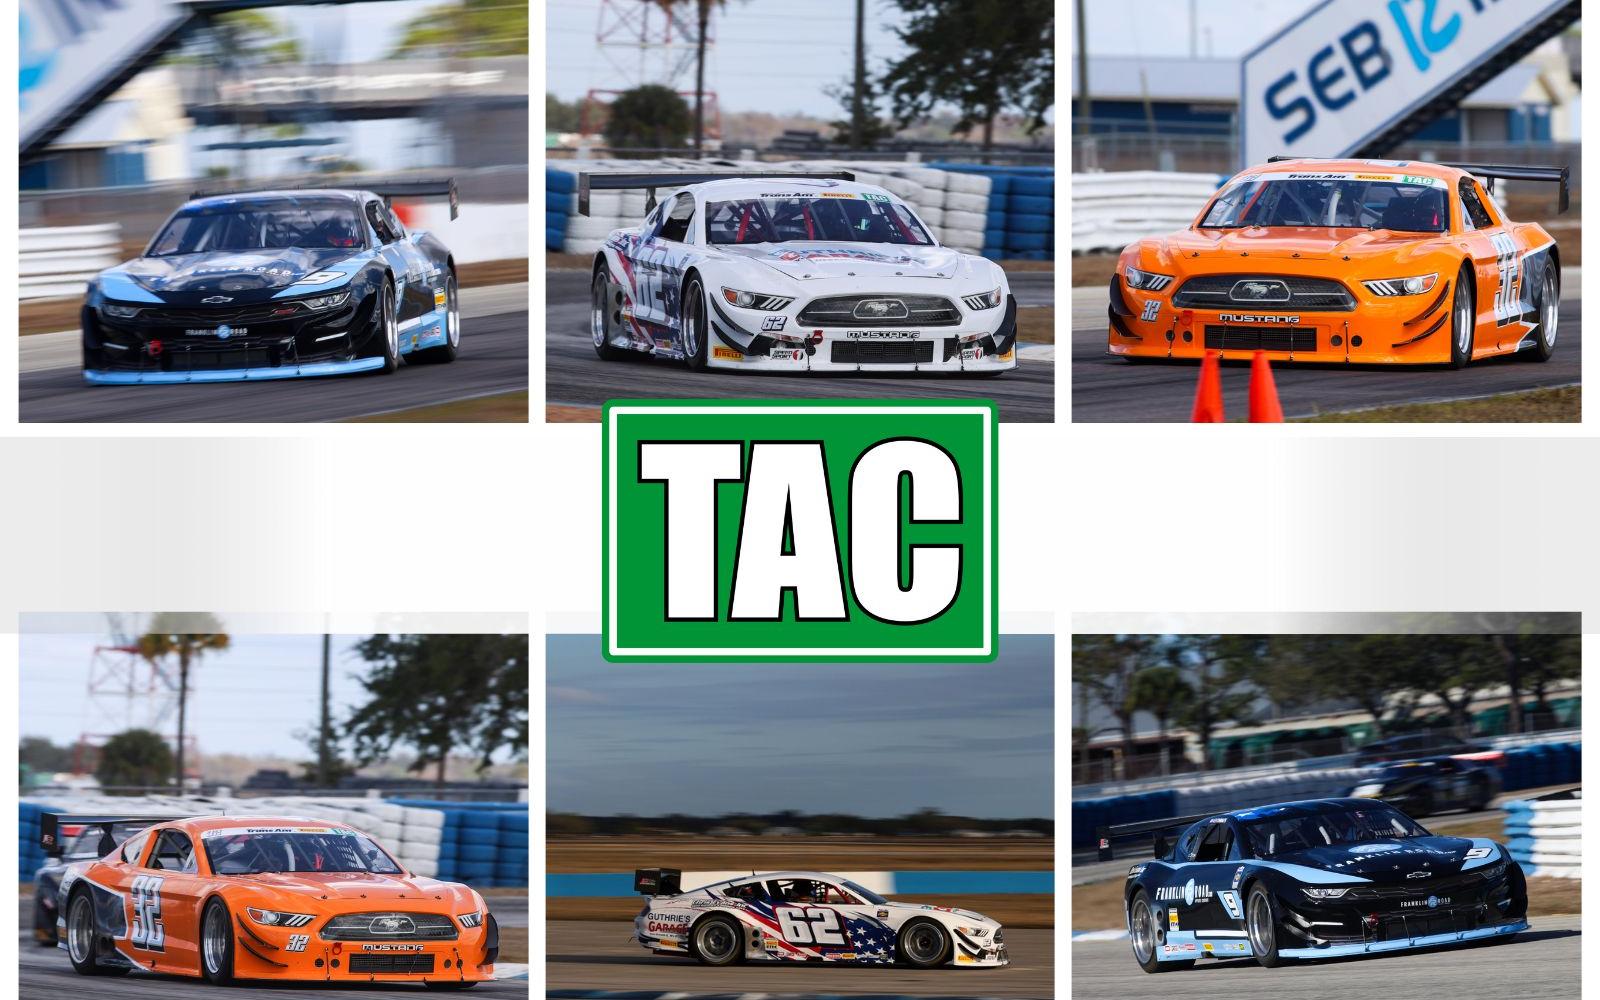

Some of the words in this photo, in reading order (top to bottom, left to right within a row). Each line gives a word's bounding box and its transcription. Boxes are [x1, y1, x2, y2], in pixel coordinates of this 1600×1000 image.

[1264, 19, 1393, 146] SEB
[1407, 176, 1435, 185] TAC
[866, 193, 889, 203] TAC
[291, 271, 347, 286] 9
[1141, 299, 1162, 322] 32
[761, 315, 787, 331] 62
[1219, 313, 1300, 323] MUSTANG
[847, 330, 921, 339] MUSTANG
[1462, 847, 1494, 861] 9
[1156, 885, 1185, 901] FRANKLIN
[1222, 891, 1241, 918] 9
[1400, 898, 1429, 908] FRANKLIN
[130, 875, 166, 951] 32
[647, 912, 691, 923] GUTHRIE'S
[648, 920, 689, 934] GARAGE
[775, 906, 846, 946] 62
[285, 934, 310, 952] 32
[362, 943, 424, 951] MUSTANG
